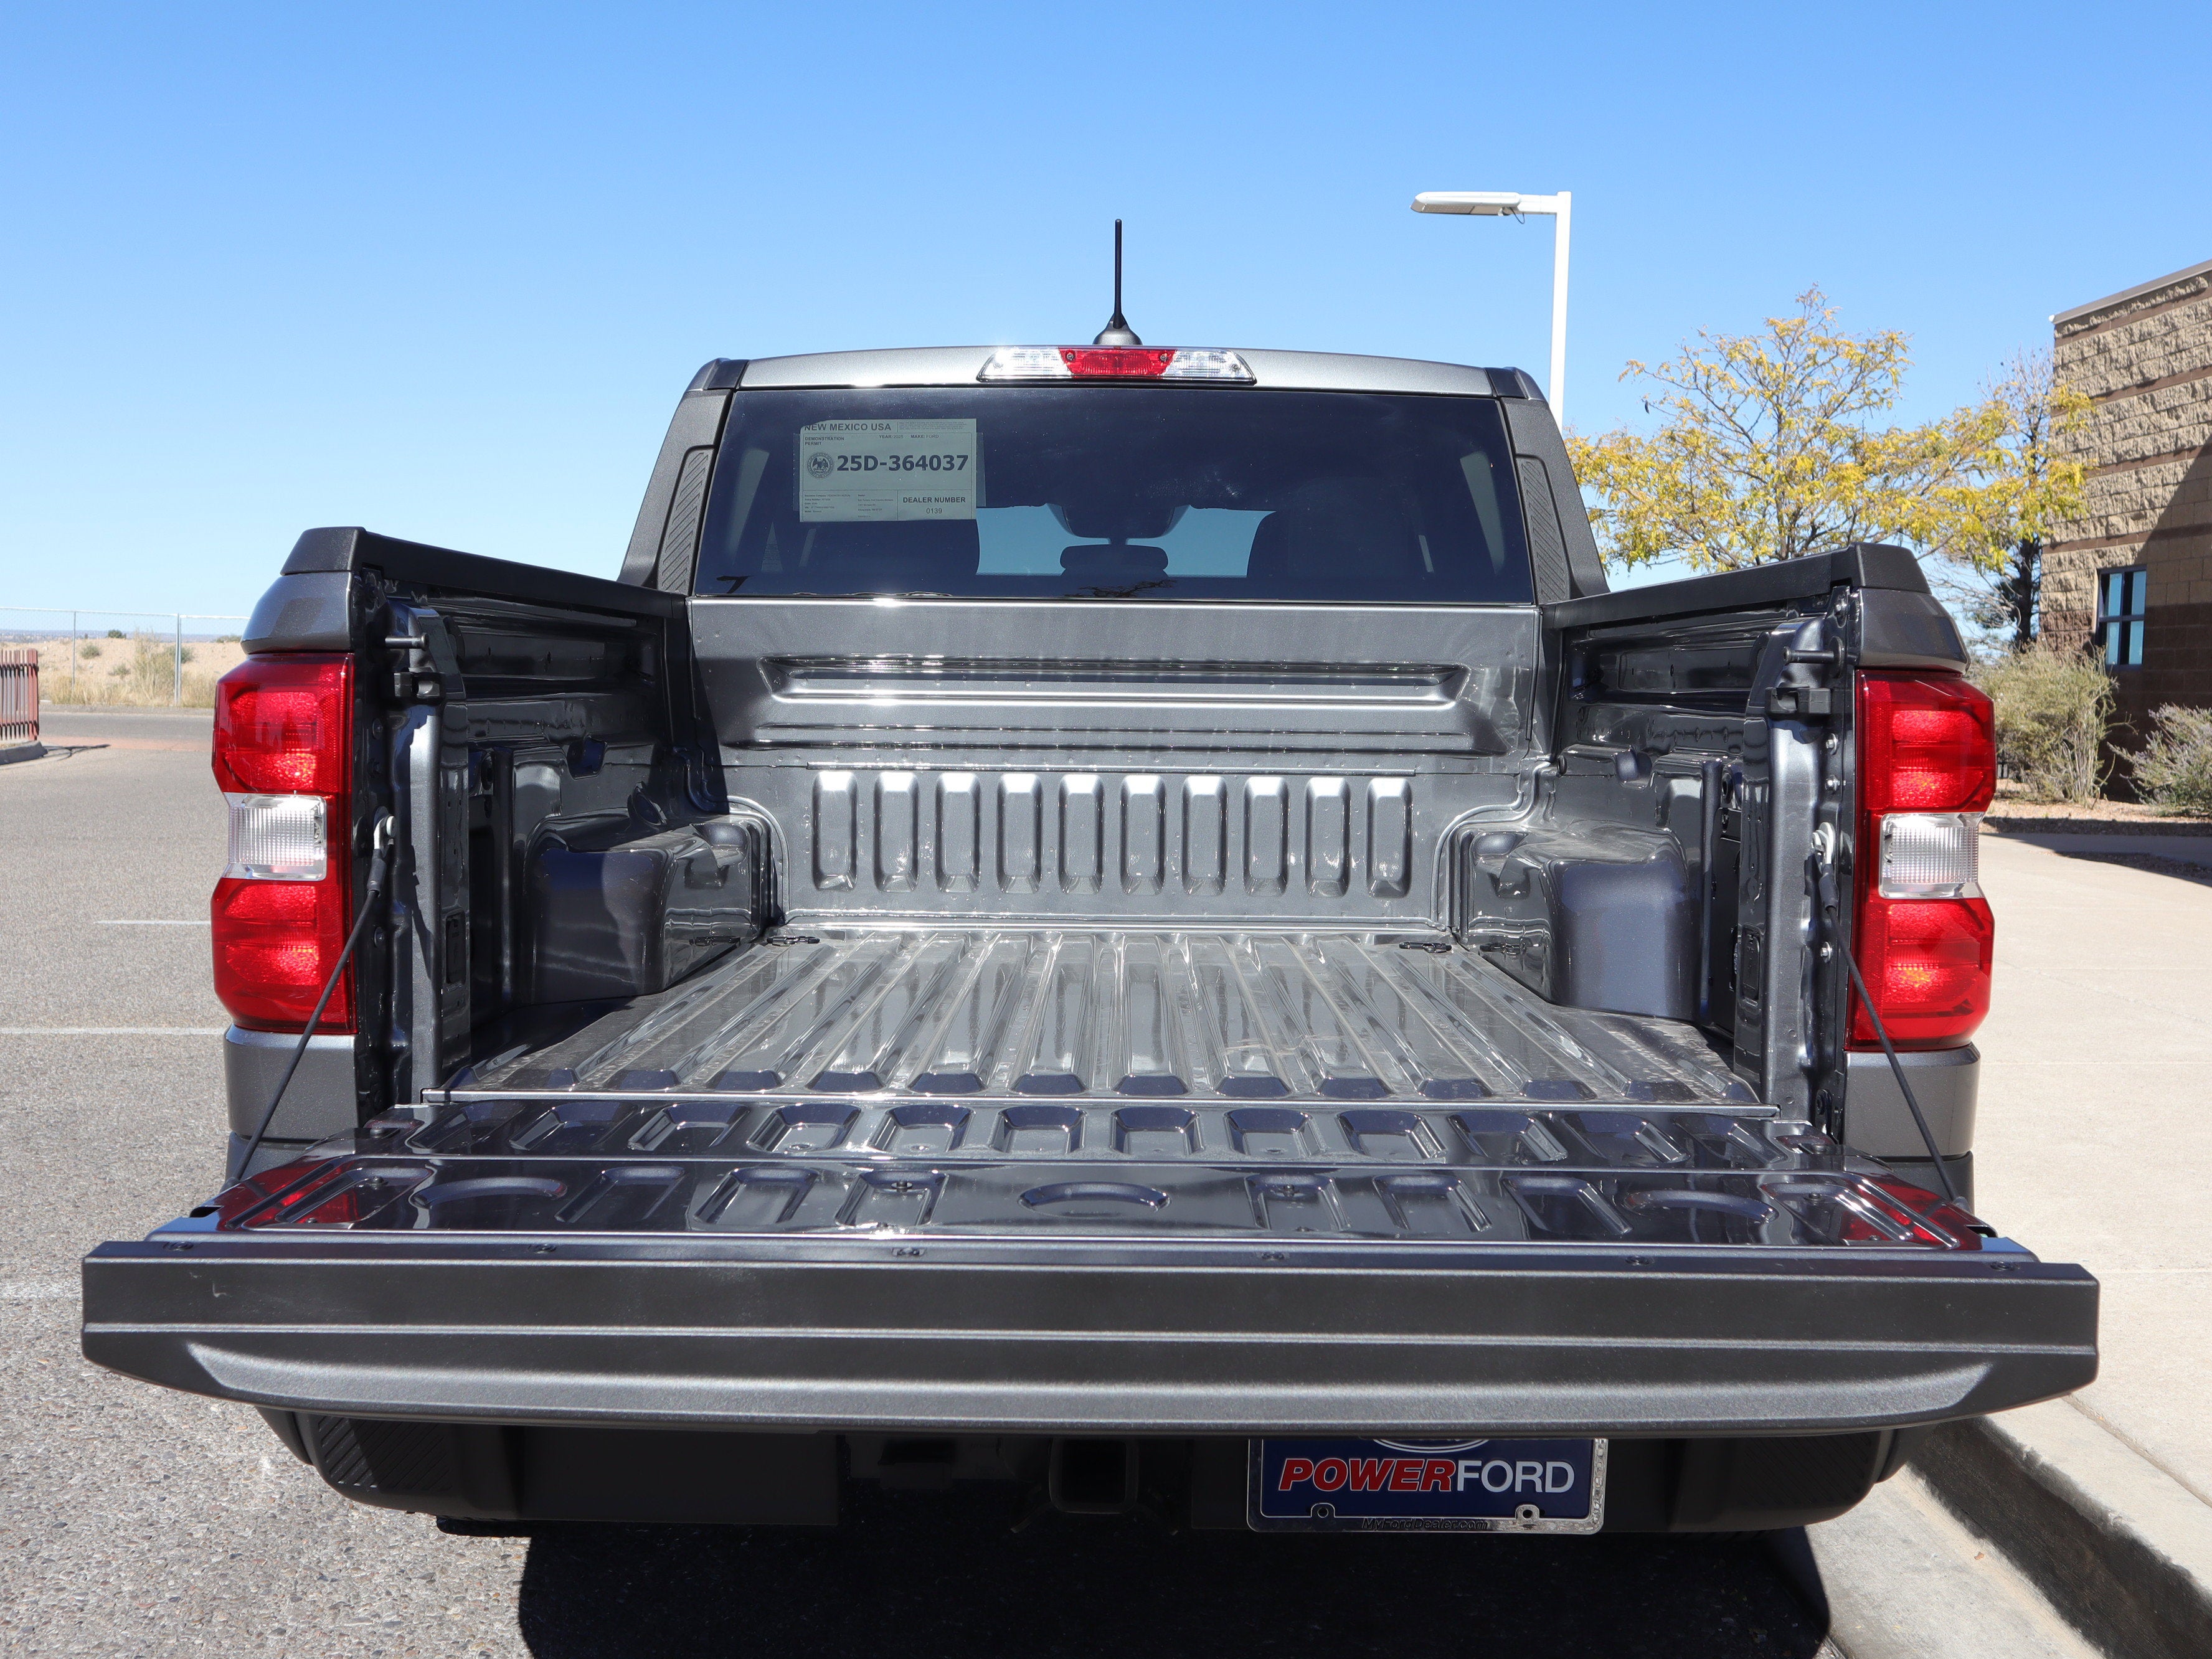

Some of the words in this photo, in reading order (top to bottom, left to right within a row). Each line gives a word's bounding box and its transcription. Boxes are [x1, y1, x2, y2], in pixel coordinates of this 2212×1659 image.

[830, 423, 868, 431] MEXICO
[871, 423, 892, 431] USA
[837, 455, 968, 471] 25D-364037
[1362, 1518, 1490, 1531] MyFordDealer.com
